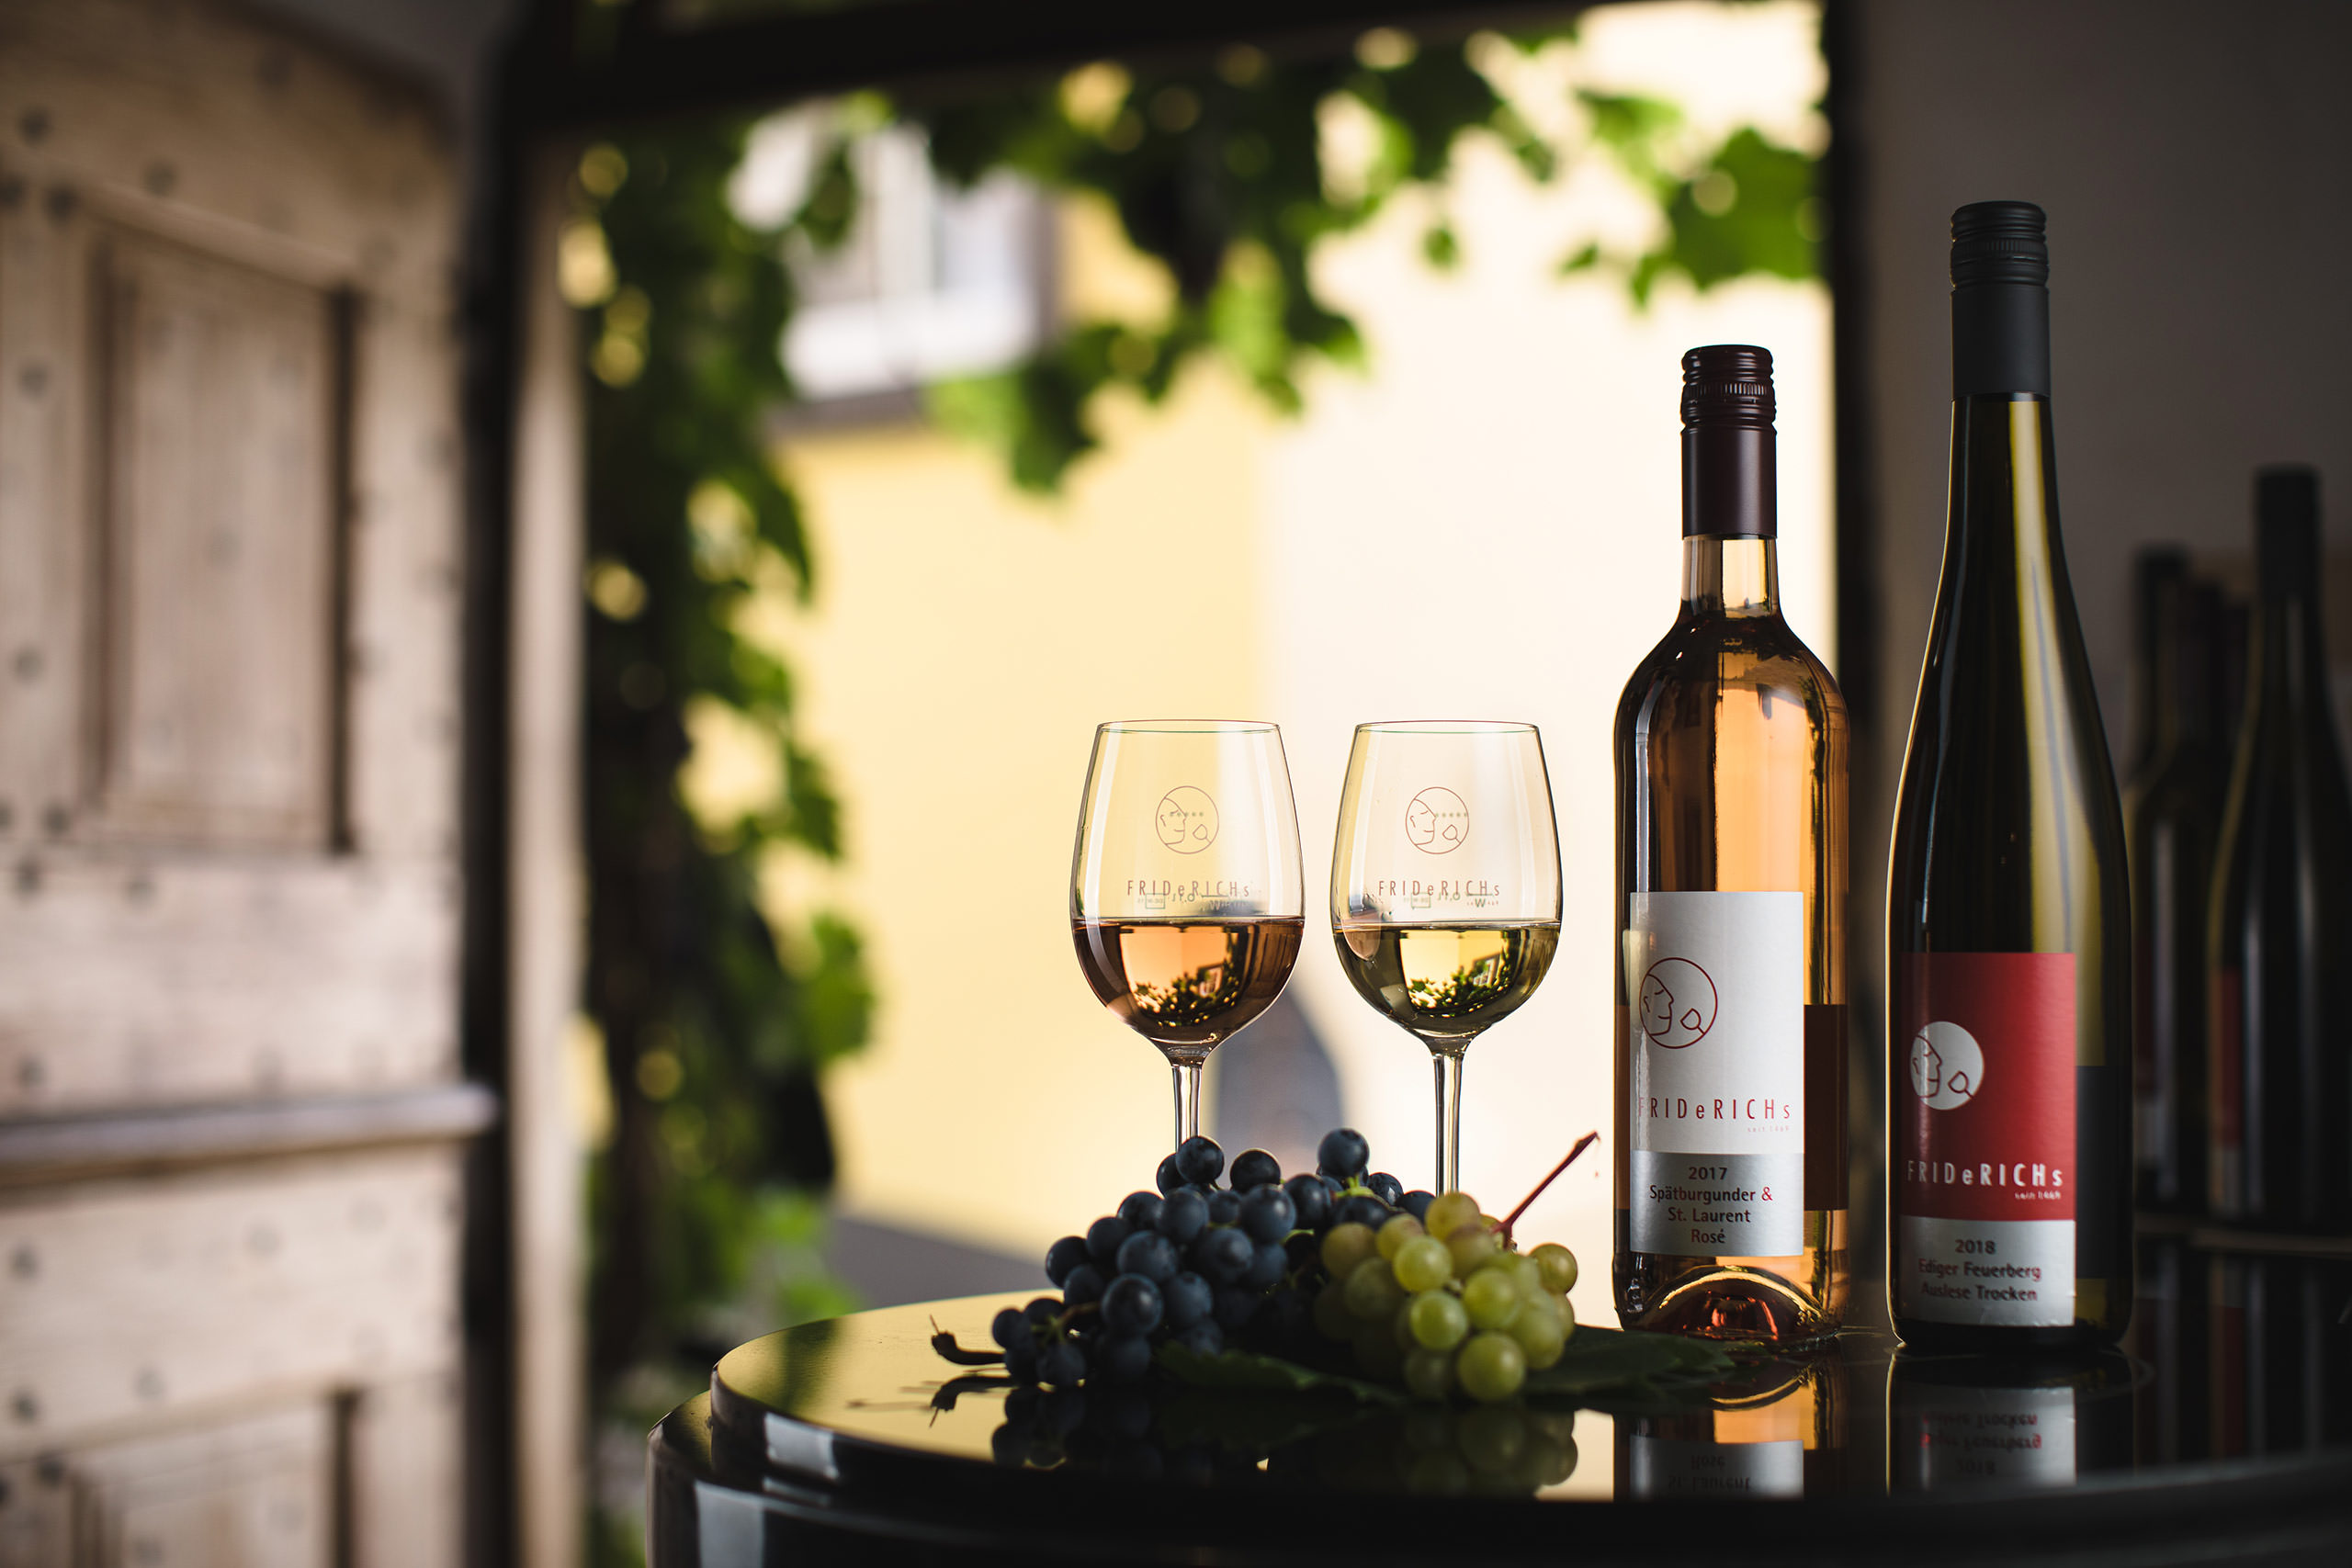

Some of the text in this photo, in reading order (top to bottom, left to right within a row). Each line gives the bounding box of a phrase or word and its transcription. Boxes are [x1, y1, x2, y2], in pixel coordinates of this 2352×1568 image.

[1127, 879, 1250, 897] FRIDeRICHs
[1378, 879, 1500, 897] FRIDeRICHs
[1638, 1096, 1791, 1120] FRIDeRICHs
[1688, 1167, 1727, 1180] 2017
[1907, 1159, 2064, 1187] FRIDeRICHs
[1649, 1185, 1773, 1205] Spätburgunder &
[1668, 1206, 1751, 1223] St. Laurent
[1690, 1228, 1726, 1244] Rosé
[1955, 1239, 1996, 1255] 2018
[1918, 1258, 2041, 1281] Ediger Feuerberg
[1921, 1282, 2038, 1302] Auslese Trocken
